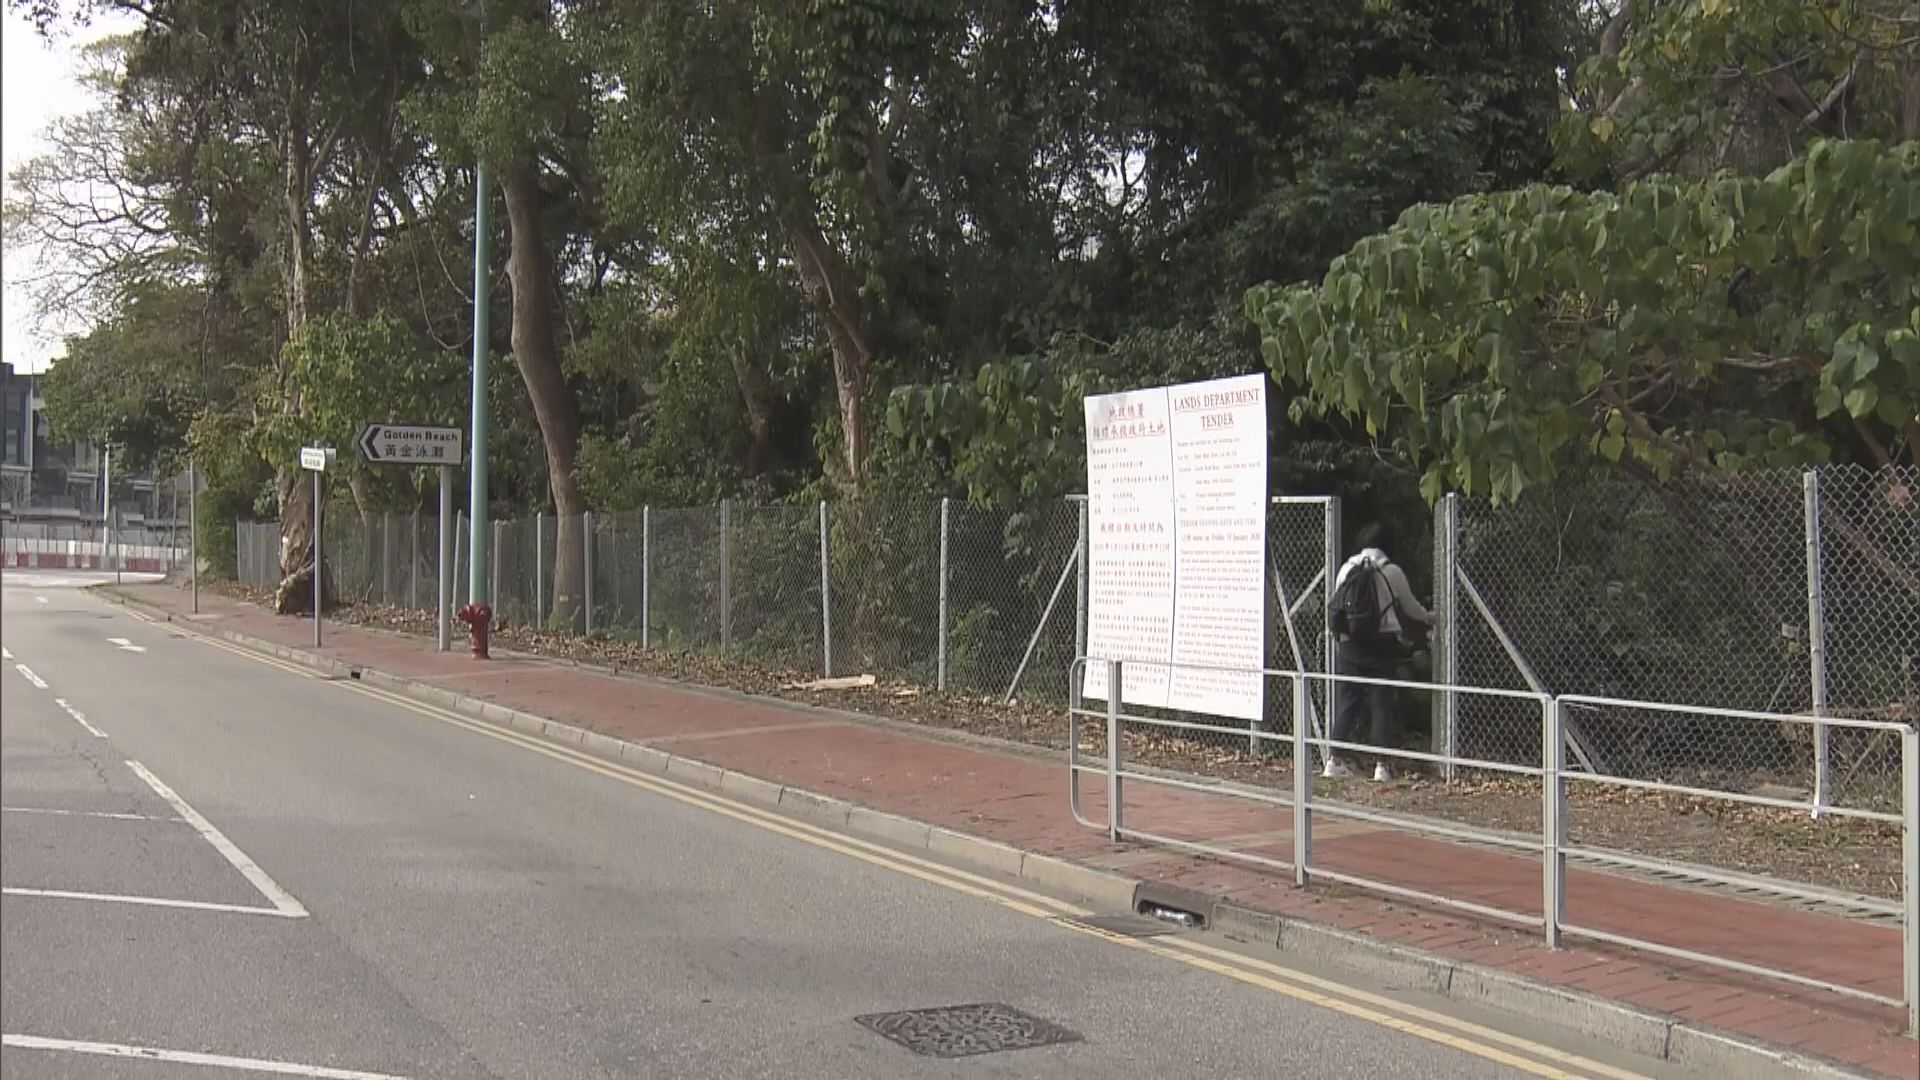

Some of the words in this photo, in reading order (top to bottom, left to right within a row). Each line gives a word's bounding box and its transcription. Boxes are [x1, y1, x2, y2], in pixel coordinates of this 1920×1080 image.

[1174, 395, 1201, 411] LANDS
[1204, 388, 1260, 407] DEPARTMENT
[1200, 412, 1234, 428] TENDER
[384, 430, 422, 440] Golden
[425, 430, 458, 442] Beach
